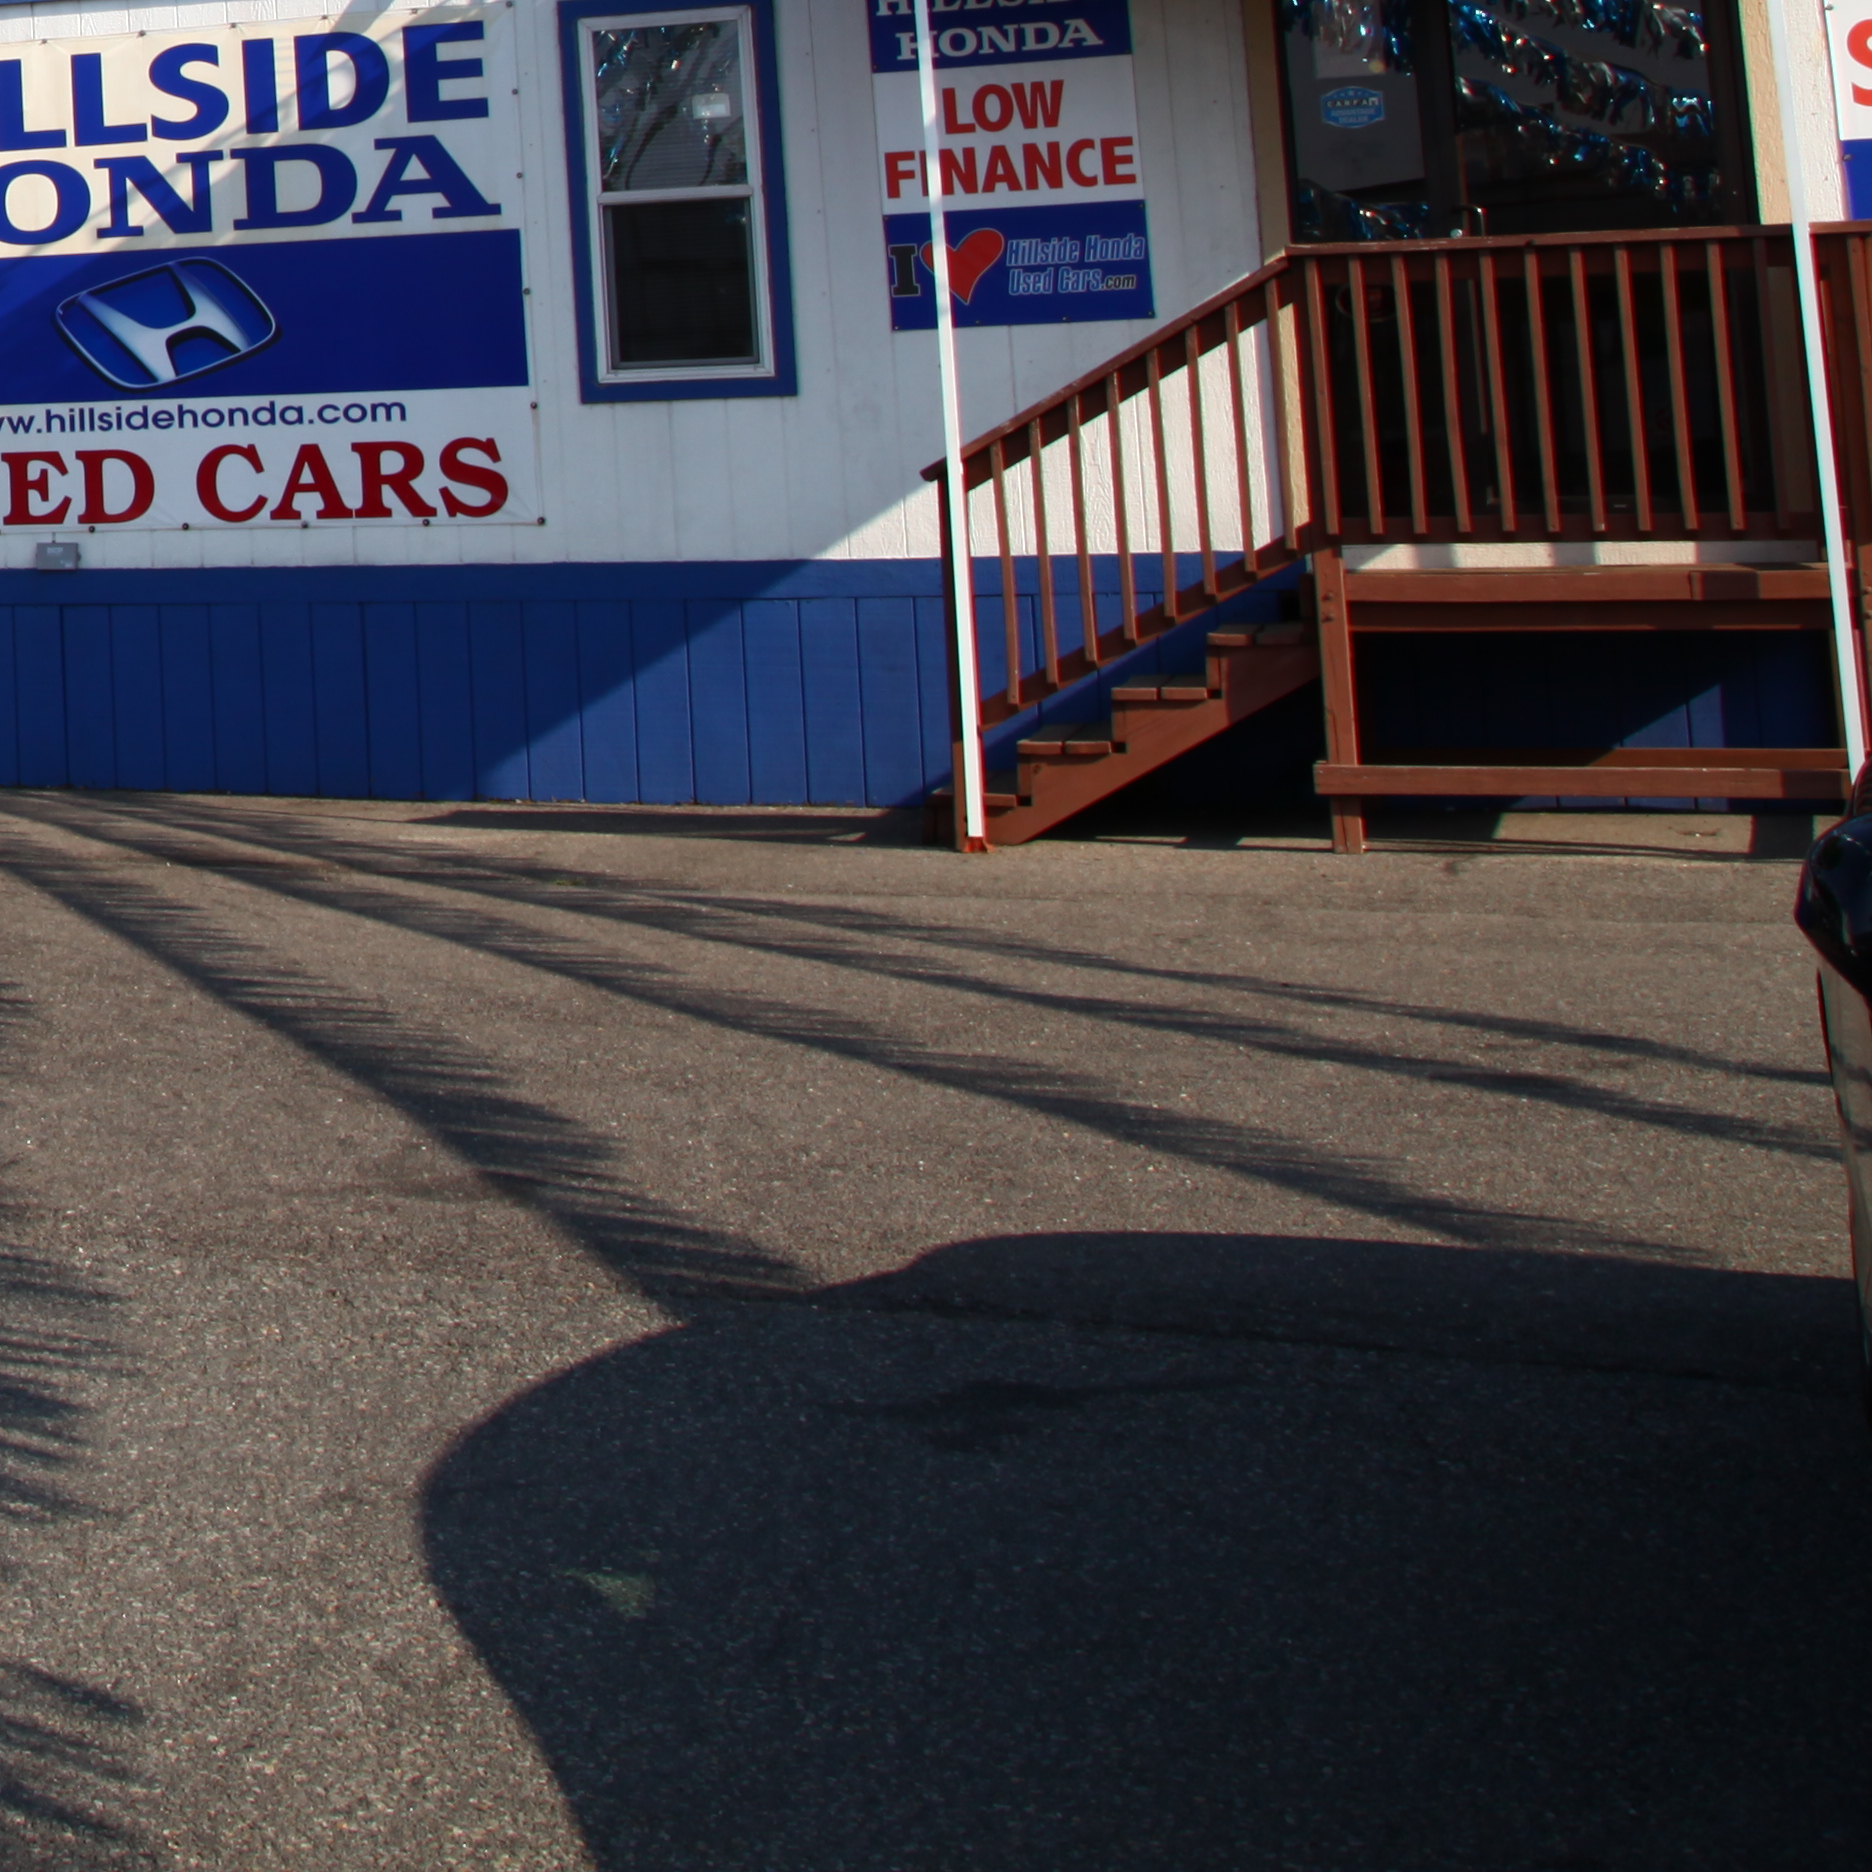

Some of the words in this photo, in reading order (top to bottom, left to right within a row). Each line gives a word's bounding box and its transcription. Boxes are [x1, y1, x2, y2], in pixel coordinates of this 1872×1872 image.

[942, 79, 1064, 135] LOW
[889, 244, 921, 297] I
[1006, 237, 1079, 267] Hillside
[1084, 234, 1145, 262] Honda
[1008, 268, 1053, 296] Used
[1056, 266, 1136, 293] Cars.com
[195, 436, 511, 524] CARS
